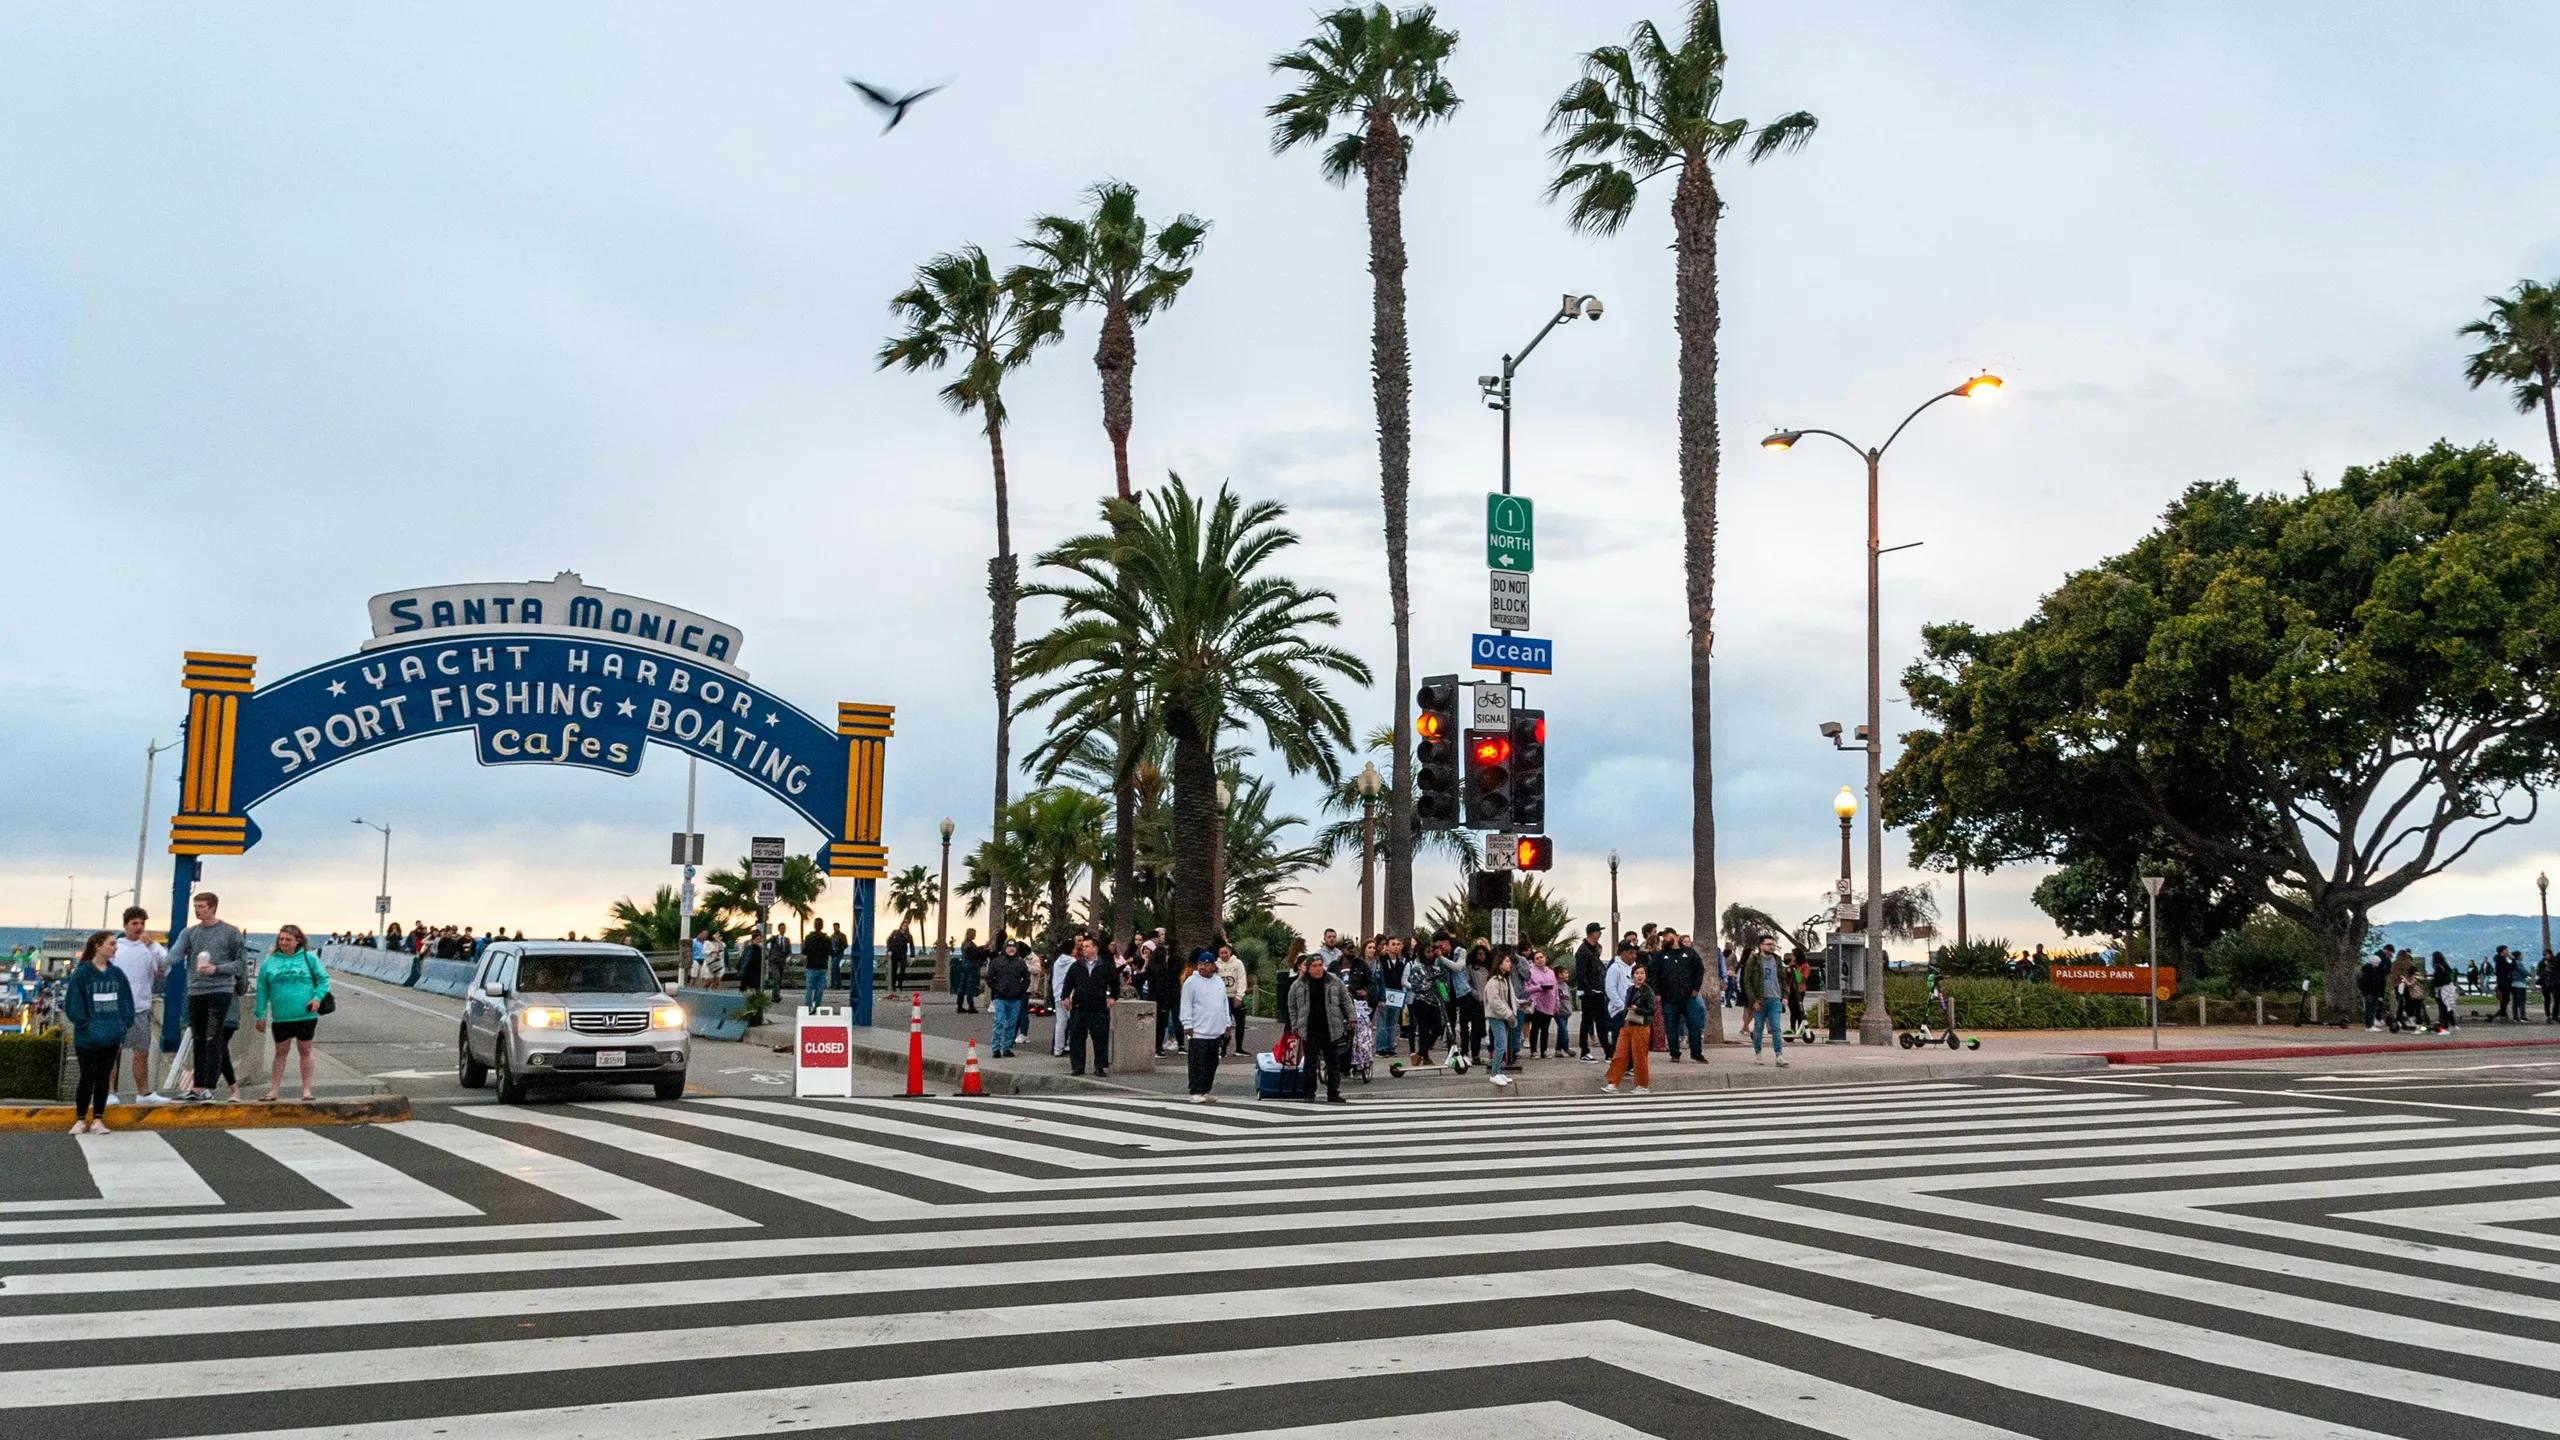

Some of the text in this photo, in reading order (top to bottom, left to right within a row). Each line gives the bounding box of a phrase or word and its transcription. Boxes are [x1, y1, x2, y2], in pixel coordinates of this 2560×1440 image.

[1508, 509, 1513, 526] 1
[1489, 533, 1531, 551] NORTH
[1493, 578, 1527, 594] DO NOT
[1493, 597, 1527, 613] BLOCK
[1492, 613, 1527, 625] INTERSECTION
[390, 595, 730, 662] SANTA MONICA
[1478, 638, 1546, 663] Ocean
[361, 646, 753, 718] YACHT HARBOR
[1476, 713, 1506, 724] SIGNAL
[270, 681, 812, 795] SPORT FISHING BOATING
[1487, 852, 1499, 866] OK
[761, 882, 772, 891] NO
[2056, 969, 2135, 979] PALISADES PARK
[805, 1042, 844, 1054] CLOSED
